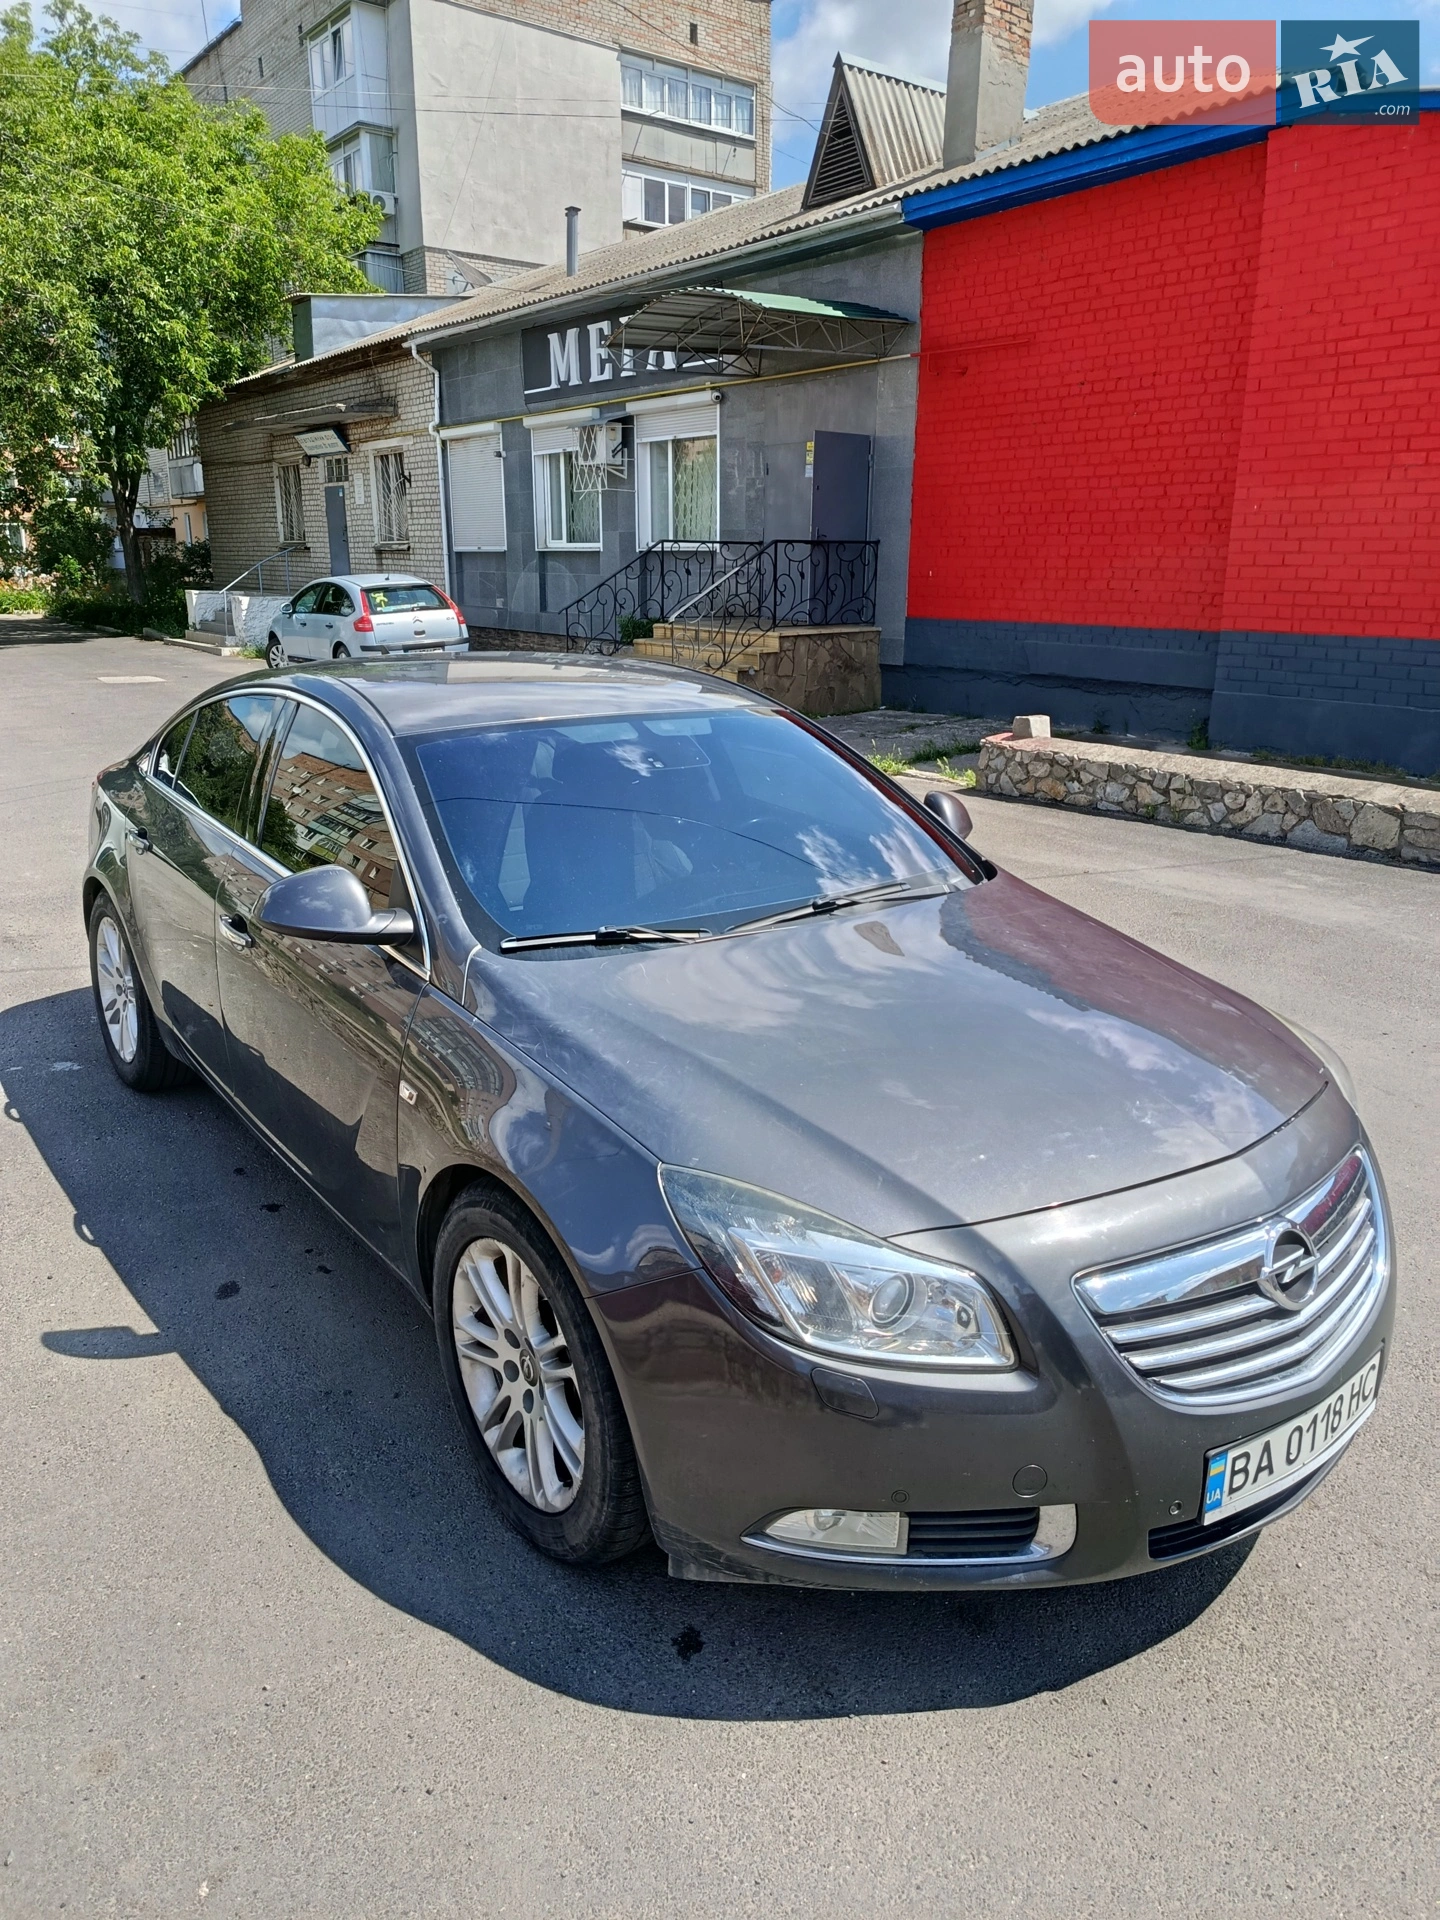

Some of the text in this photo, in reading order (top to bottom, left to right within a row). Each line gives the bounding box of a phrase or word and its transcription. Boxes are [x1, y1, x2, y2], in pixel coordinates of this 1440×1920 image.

[1227, 1363, 1377, 1497] BA 0118 HC
[1206, 1489, 1221, 1504] UA
